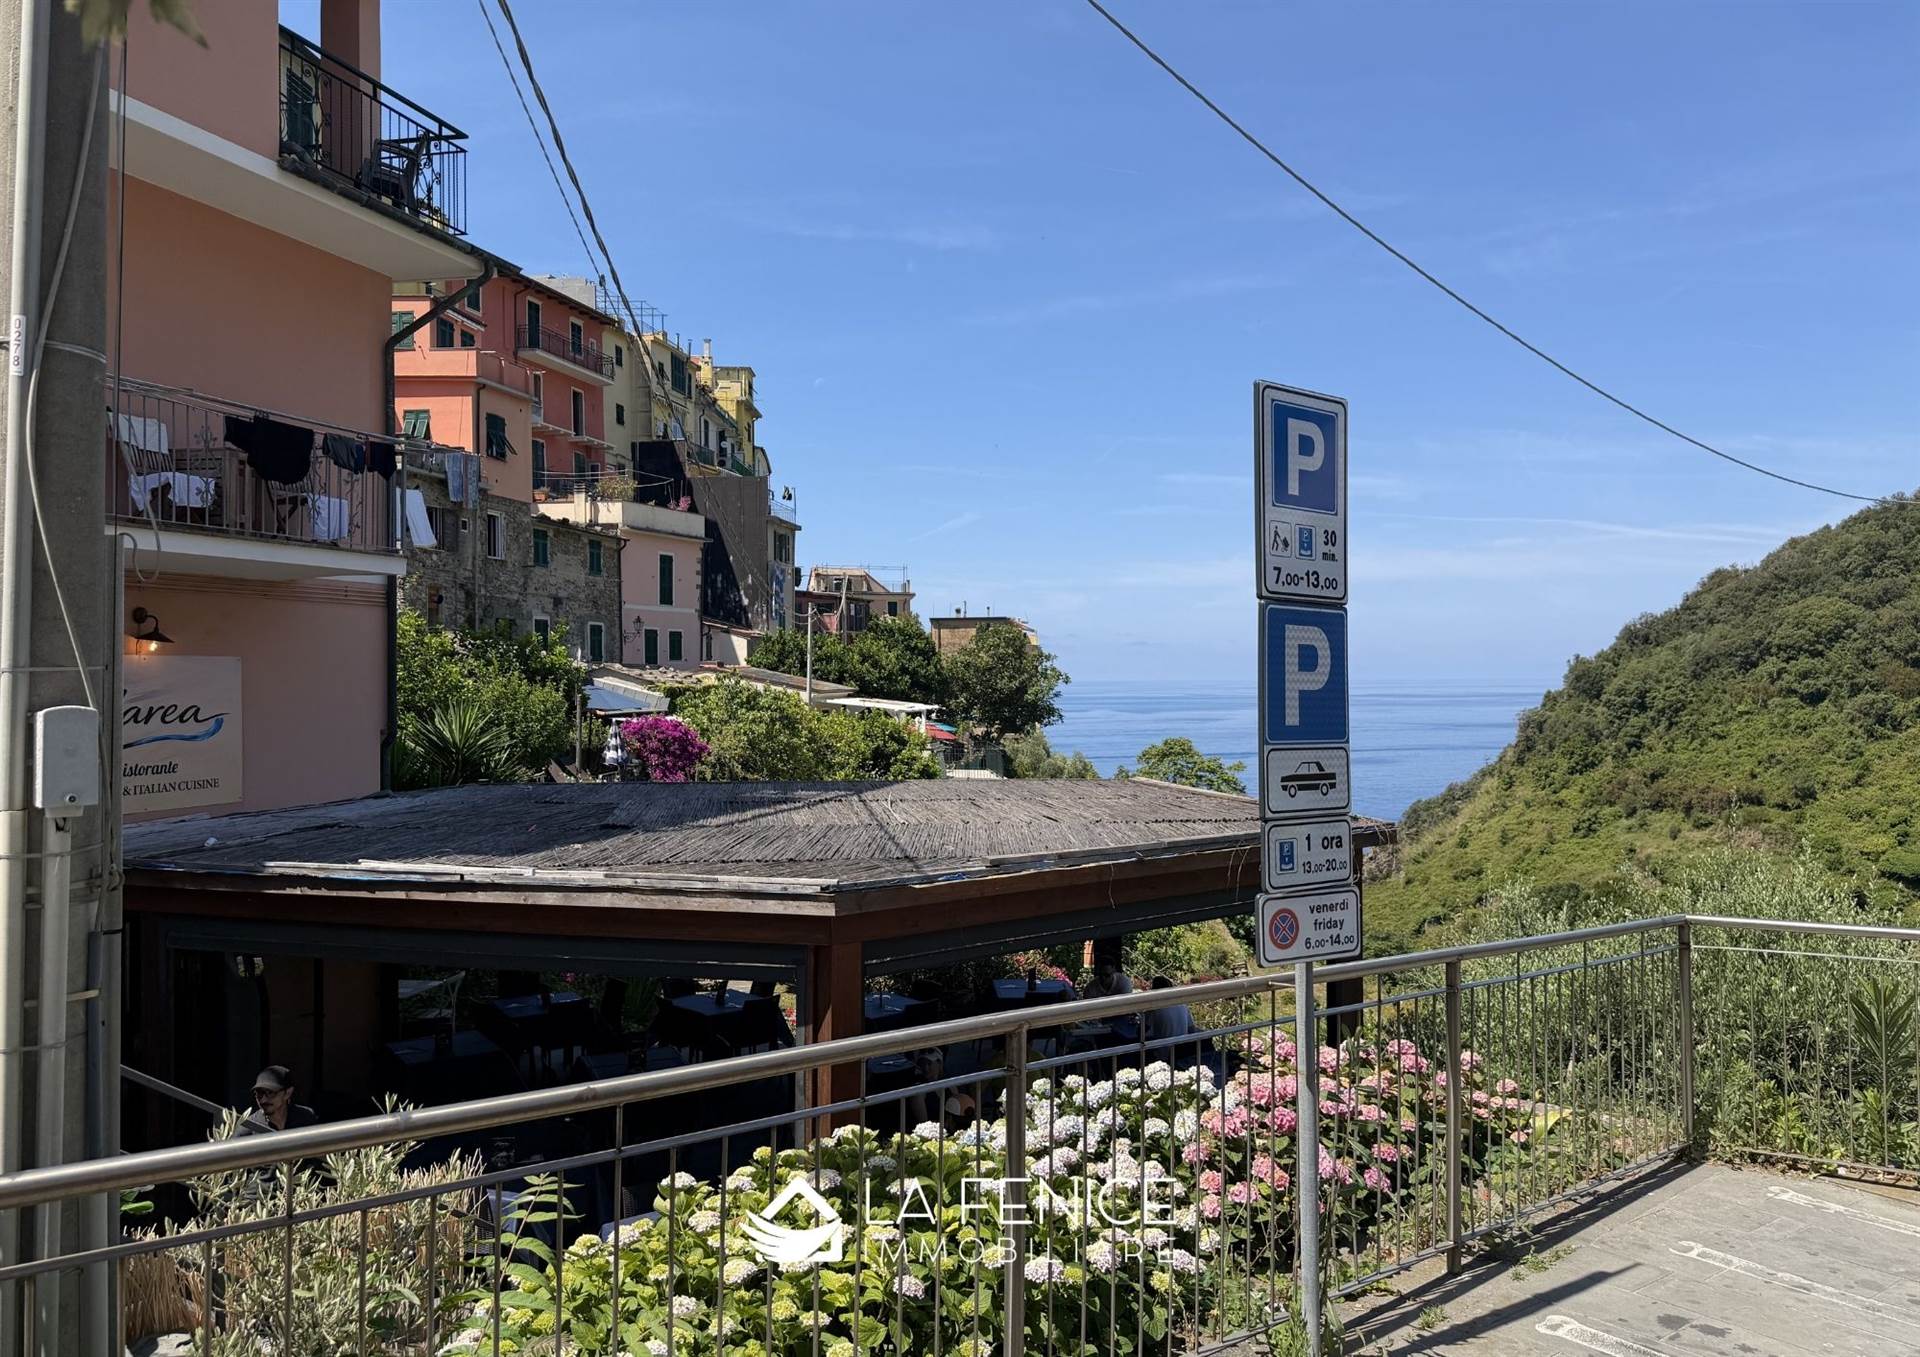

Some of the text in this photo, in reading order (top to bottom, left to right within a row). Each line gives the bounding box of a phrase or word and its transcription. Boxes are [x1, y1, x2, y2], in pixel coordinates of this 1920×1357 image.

[1287, 417, 1325, 496] P
[1323, 529, 1337, 547] 30
[1284, 624, 1331, 727] P
[123, 693, 231, 725] area
[123, 761, 179, 777] istorante
[123, 778, 220, 796] & ITALIAN CUISINE
[1305, 833, 1311, 851] 1
[1321, 835, 1343, 850] ora
[1313, 918, 1344, 931] friday
